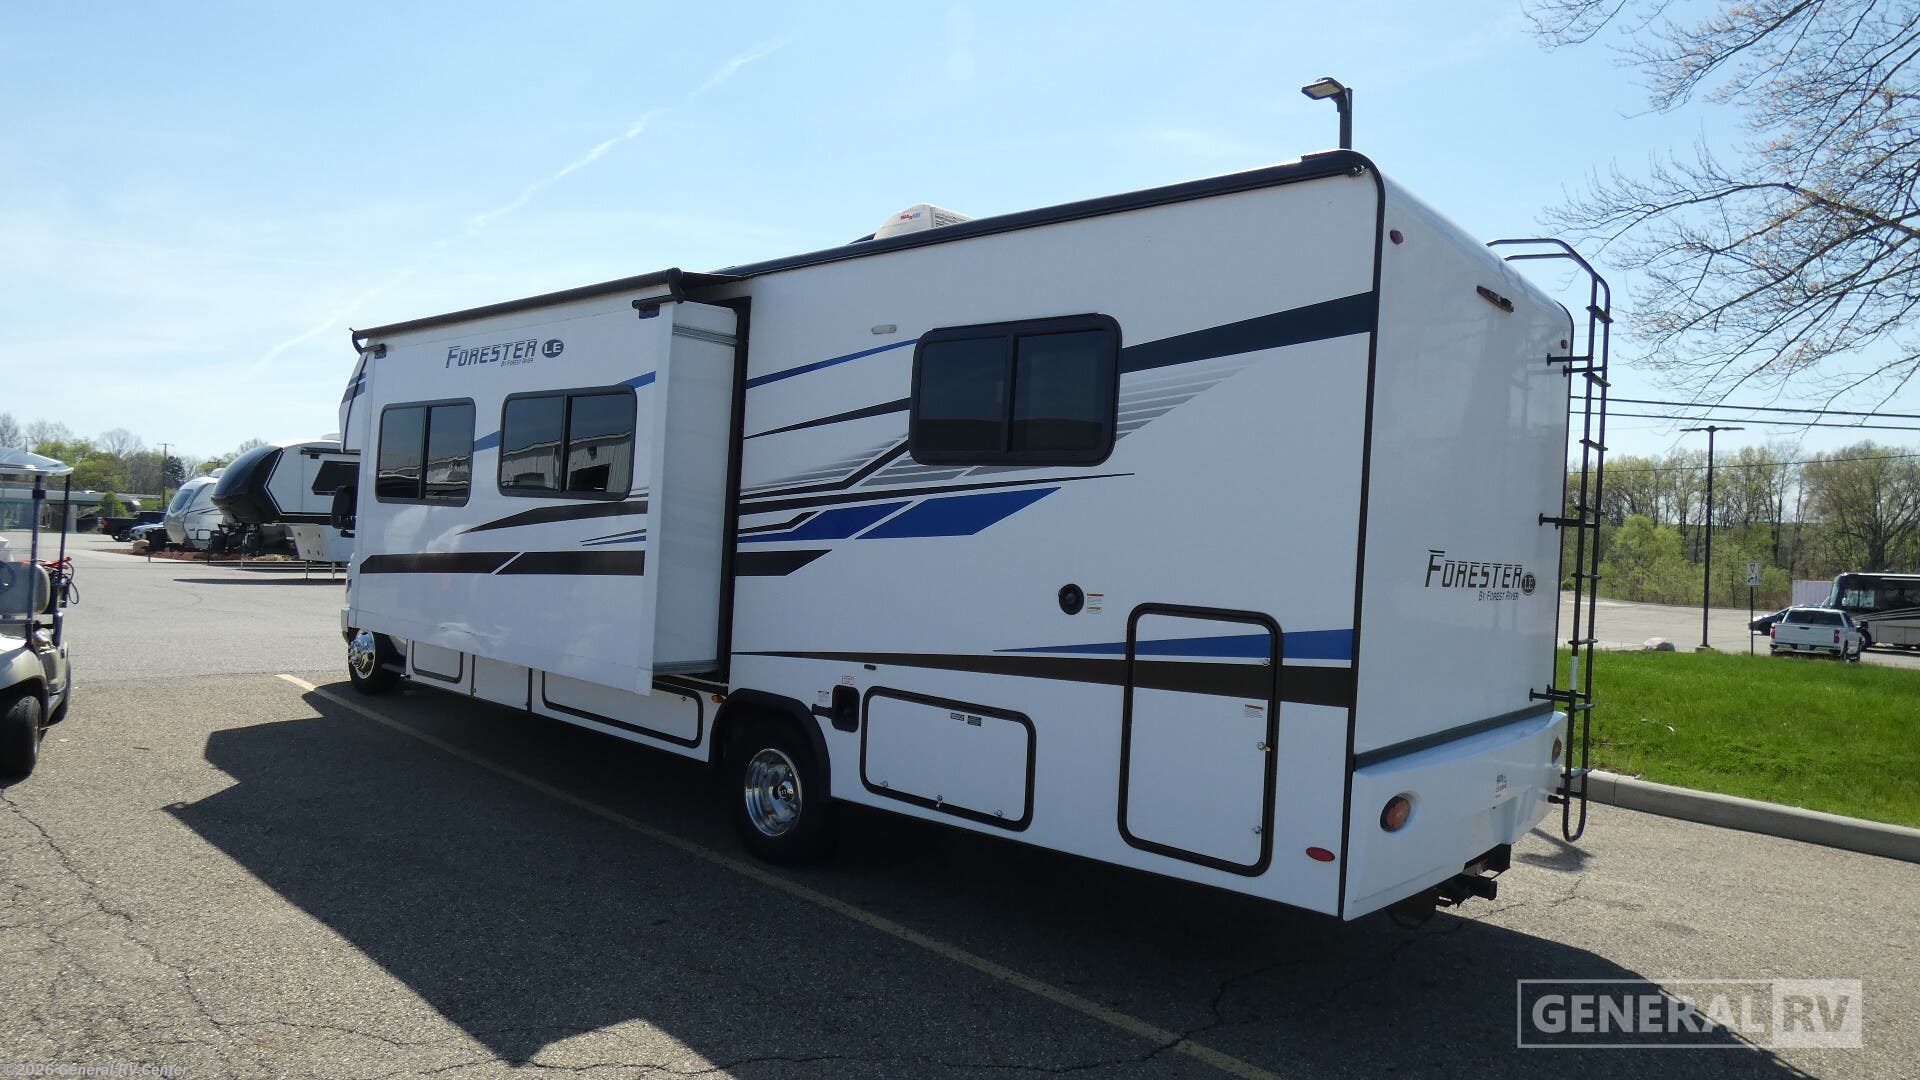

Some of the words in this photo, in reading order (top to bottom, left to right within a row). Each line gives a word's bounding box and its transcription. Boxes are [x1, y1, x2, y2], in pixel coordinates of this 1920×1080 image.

[446, 339, 537, 368] FORESTER
[543, 341, 562, 355] LE
[1424, 549, 1523, 588] FORESTER
